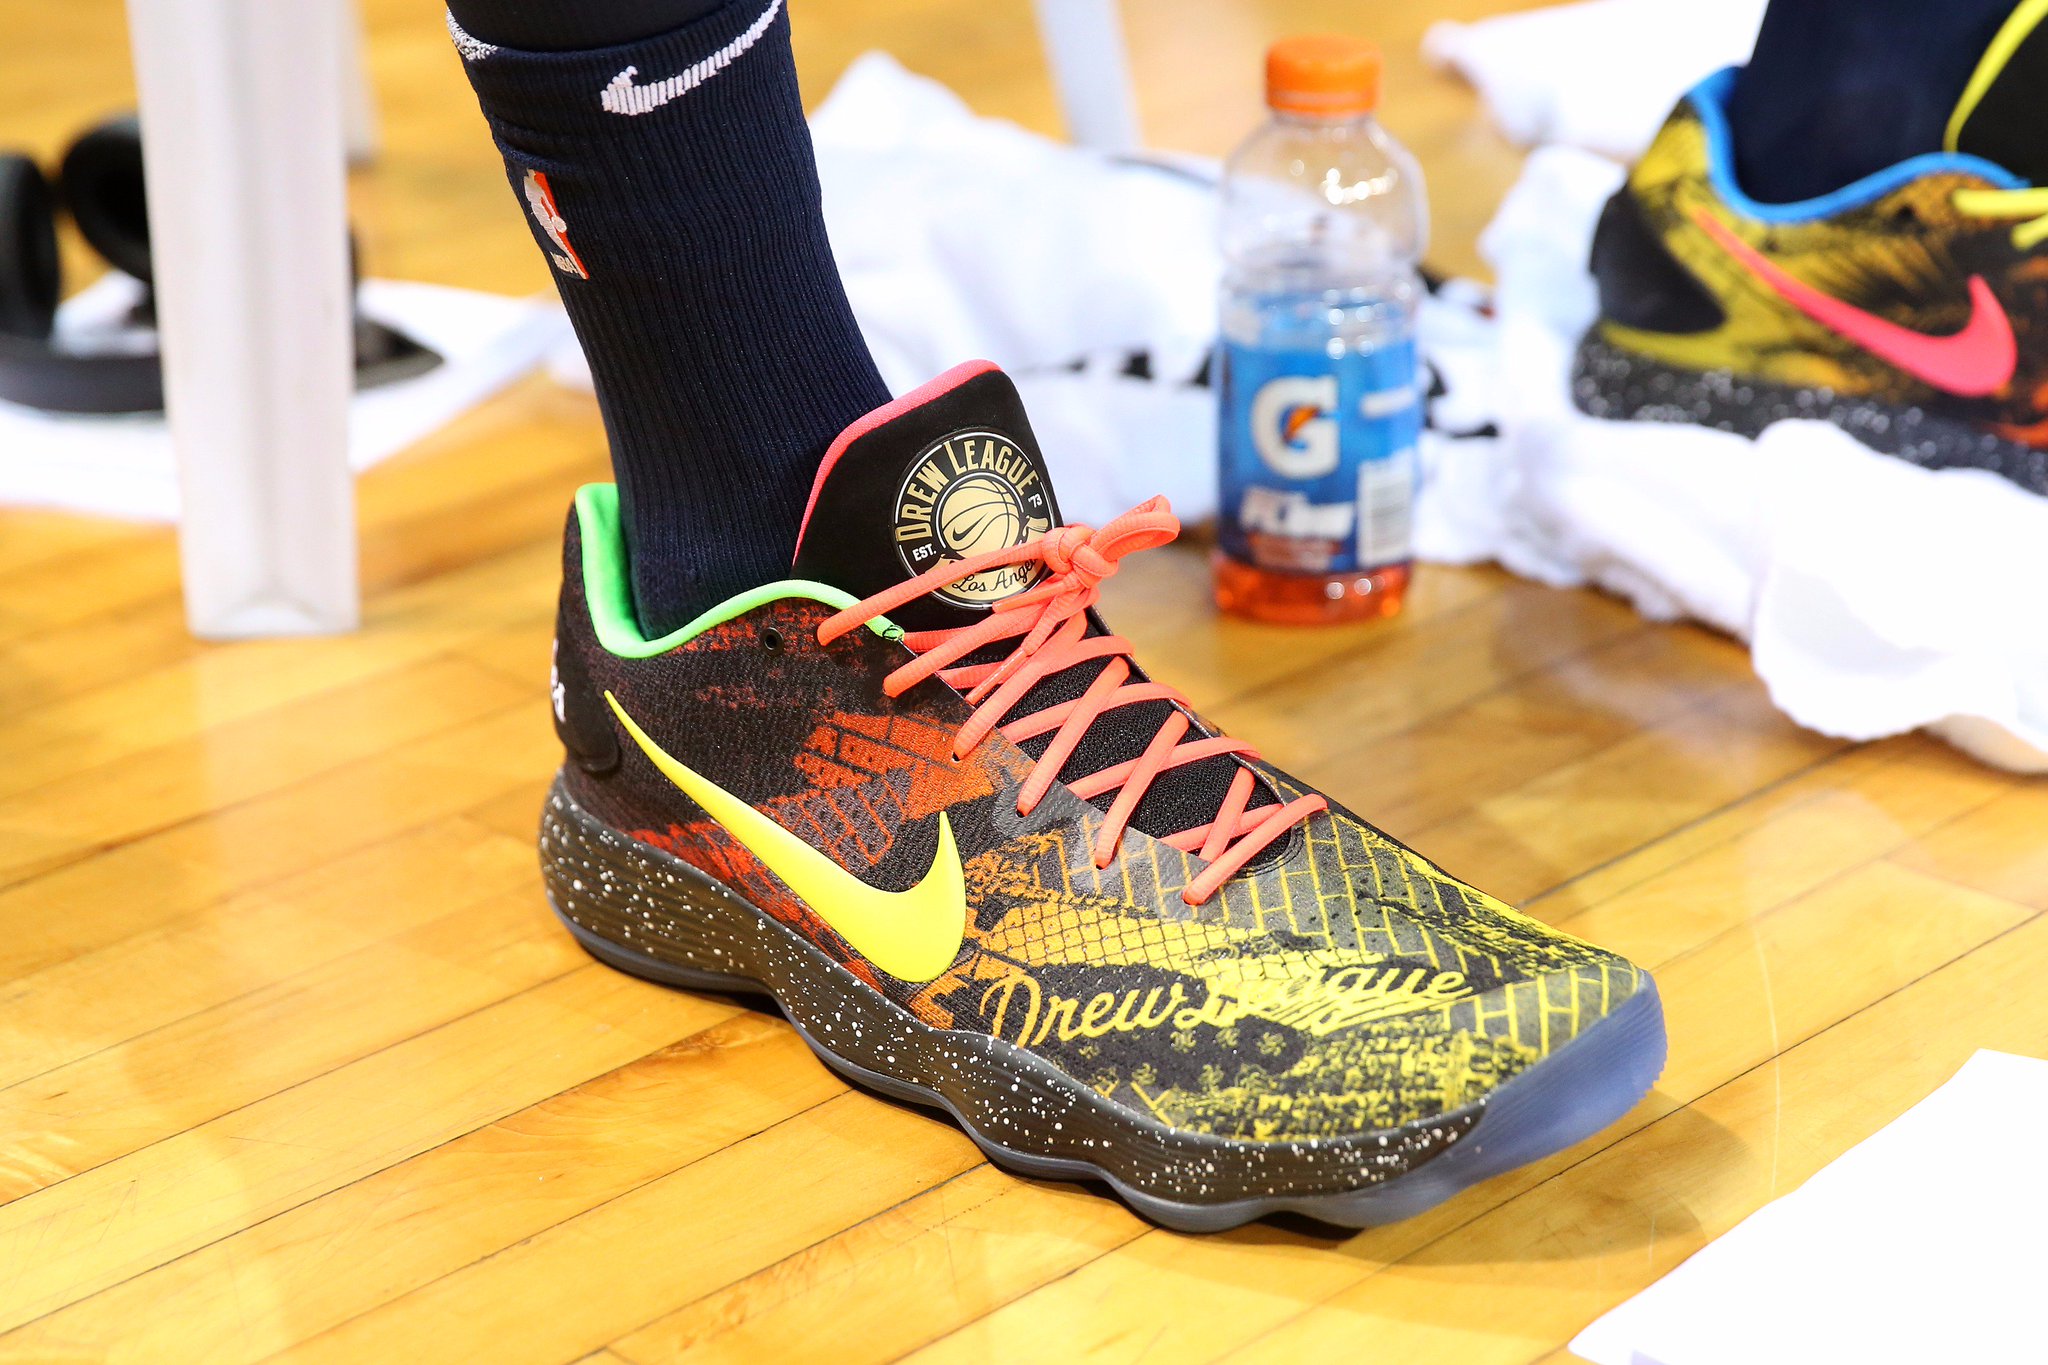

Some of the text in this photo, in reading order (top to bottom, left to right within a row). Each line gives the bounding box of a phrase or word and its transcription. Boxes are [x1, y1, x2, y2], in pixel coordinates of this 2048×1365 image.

[1252, 376, 1341, 479] G
[895, 439, 1039, 542] DREW LEAGUE
[912, 543, 937, 562] EST.
[951, 558, 1037, 593] Los Ange
[979, 971, 1189, 1049] Drew
